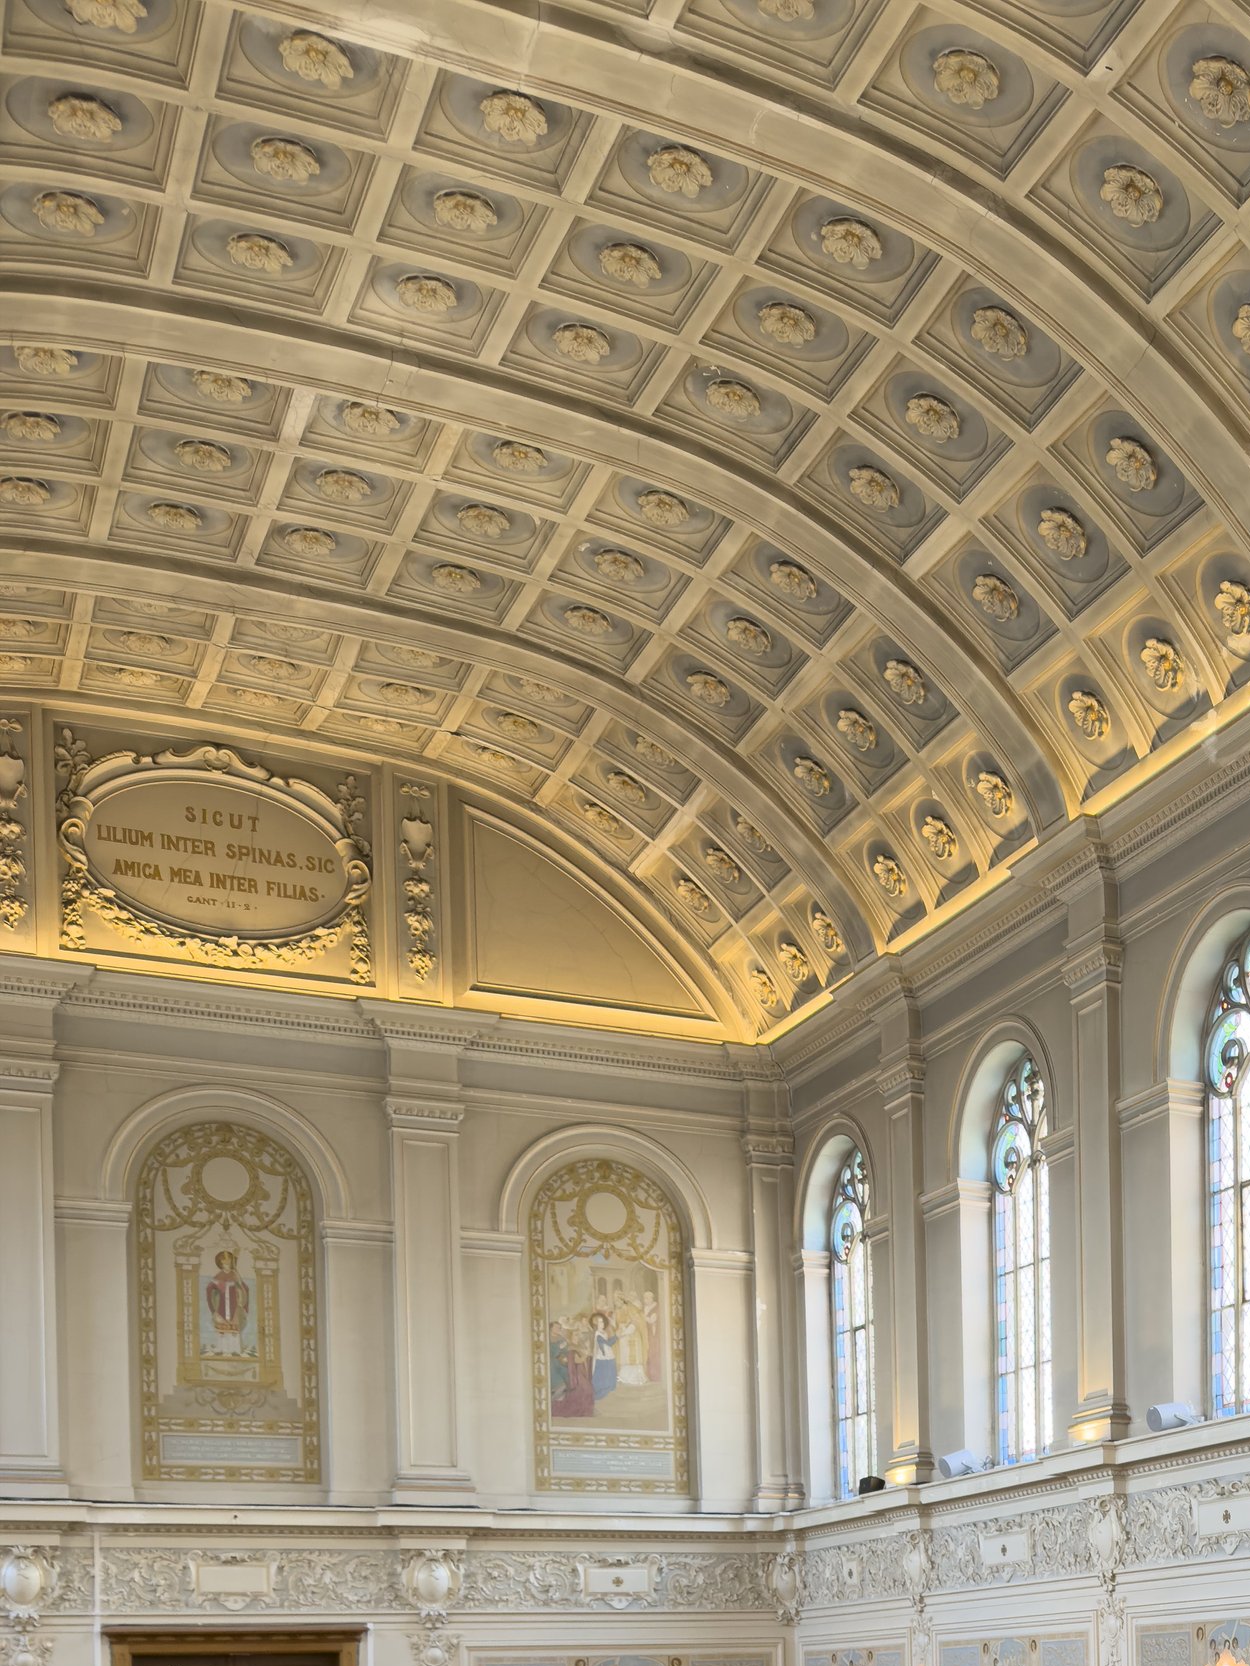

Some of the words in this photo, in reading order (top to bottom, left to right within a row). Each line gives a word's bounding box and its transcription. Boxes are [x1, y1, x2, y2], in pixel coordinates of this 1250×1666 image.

[185, 806, 260, 833] SICUT
[96, 824, 154, 848] LILIUM
[160, 833, 216, 857] INTER
[112, 858, 163, 881] AMICA
[169, 866, 204, 887] MEA
[209, 871, 258, 894] INTER
